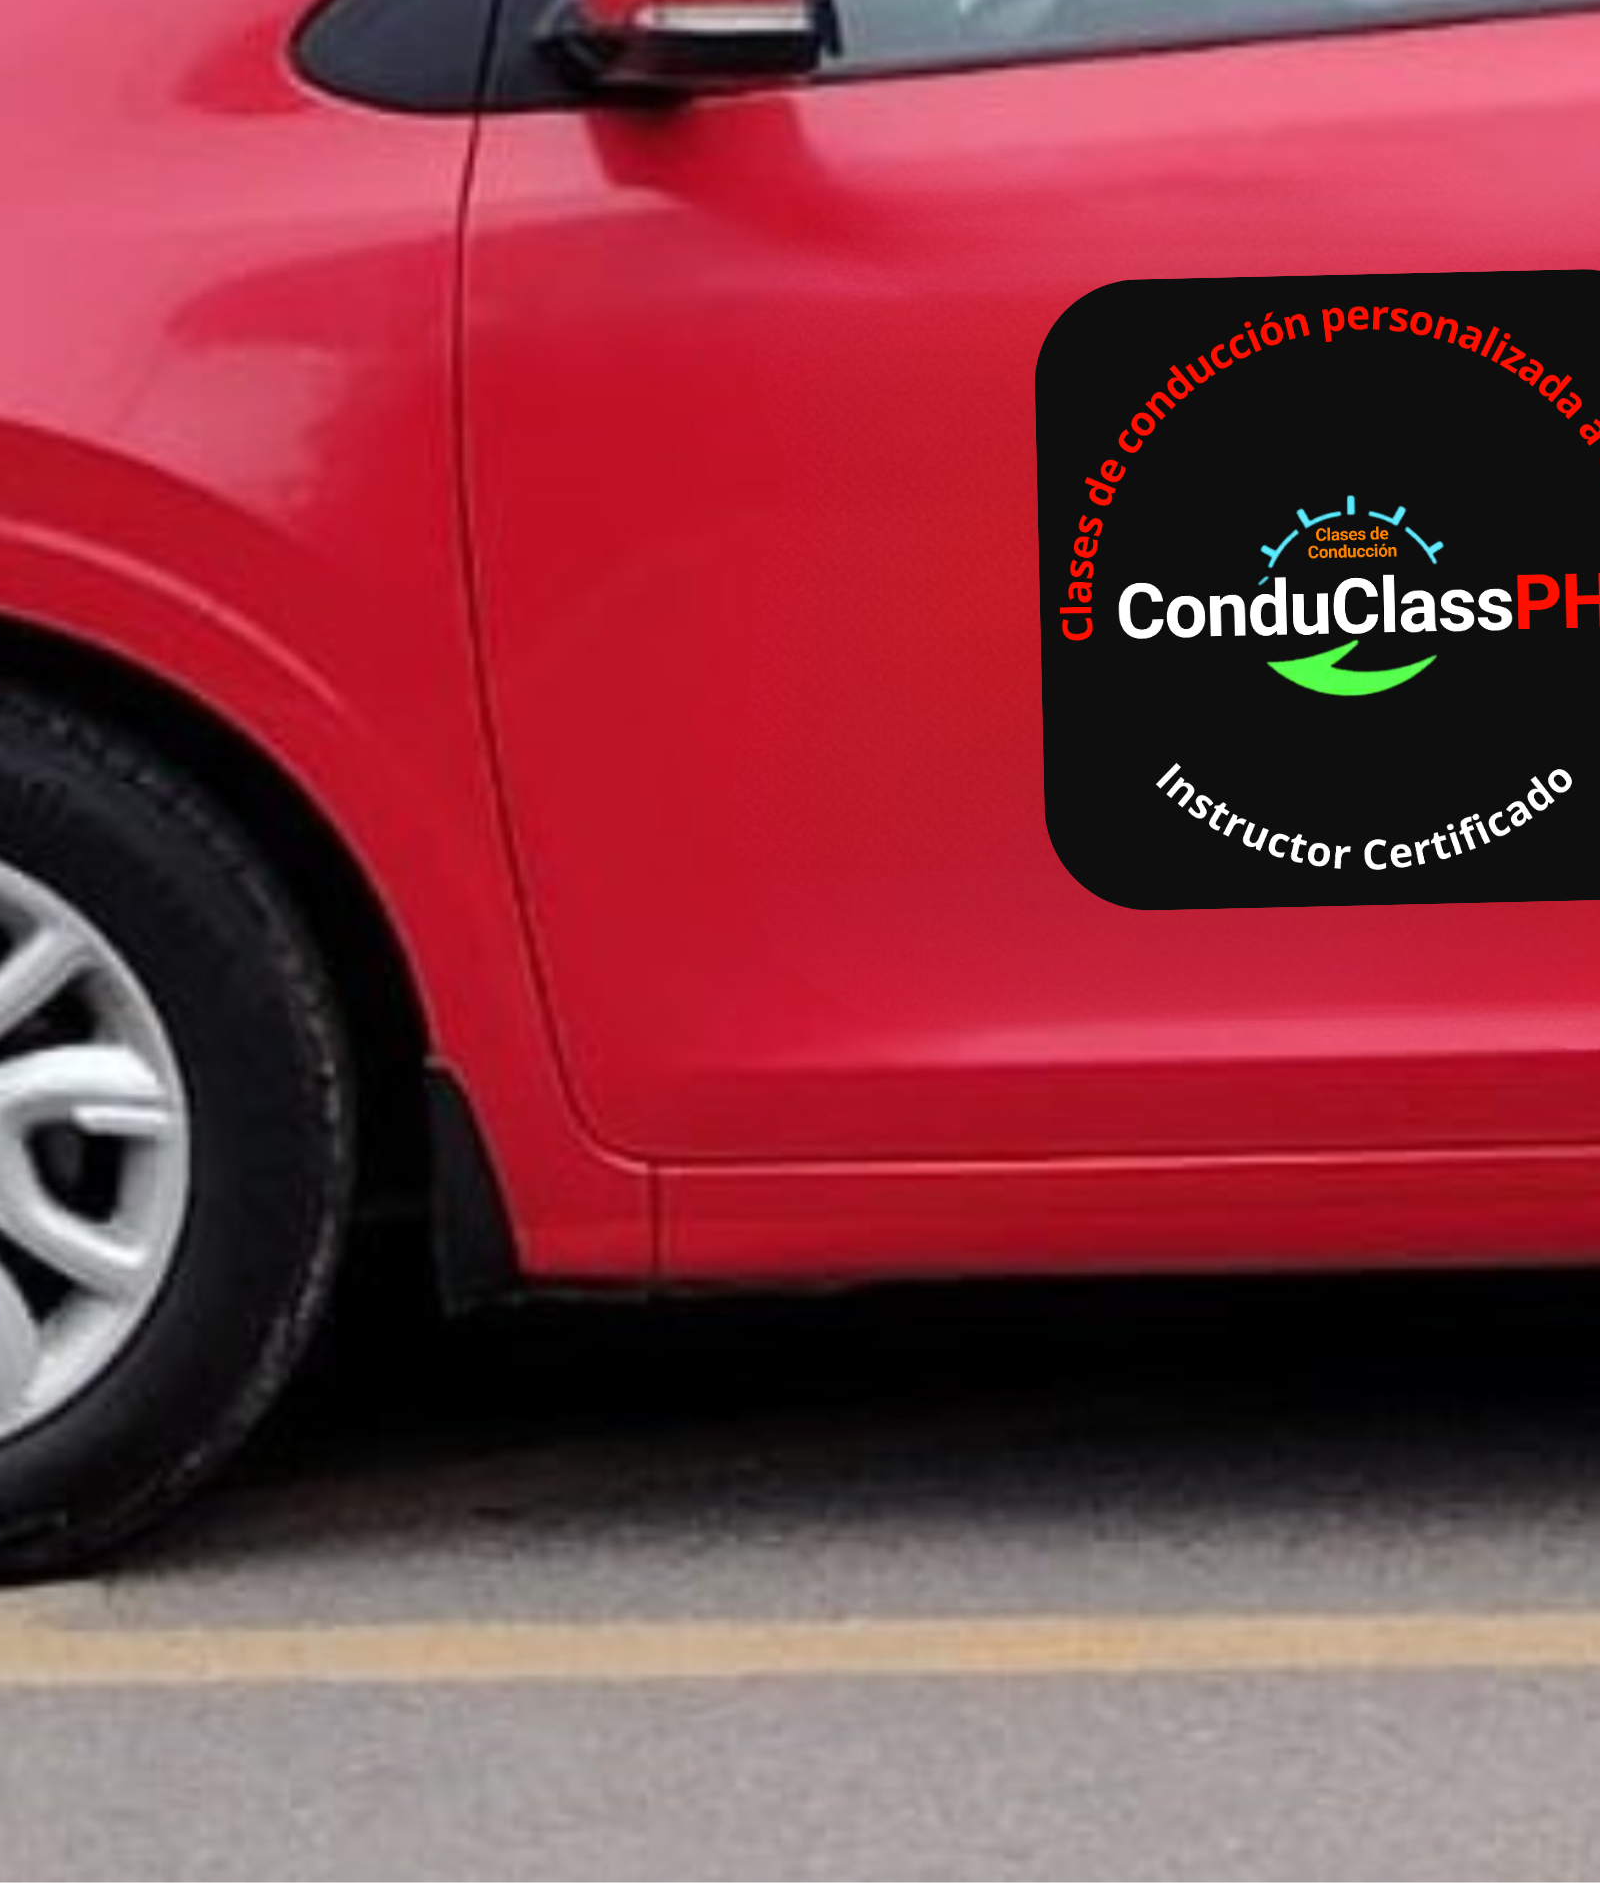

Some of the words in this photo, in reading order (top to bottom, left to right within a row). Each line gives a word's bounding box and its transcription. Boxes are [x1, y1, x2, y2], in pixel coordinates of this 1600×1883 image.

[1060, 514, 1104, 642] Clases
[1084, 459, 1127, 507] de
[1118, 311, 1311, 454] conducción
[1321, 305, 1583, 420] personalizada
[1307, 542, 1398, 559] Conducción
[1315, 526, 1367, 542] Clases
[1369, 525, 1389, 542] de
[1155, 762, 1352, 870] Instructor
[1363, 768, 1573, 871] Certificado
